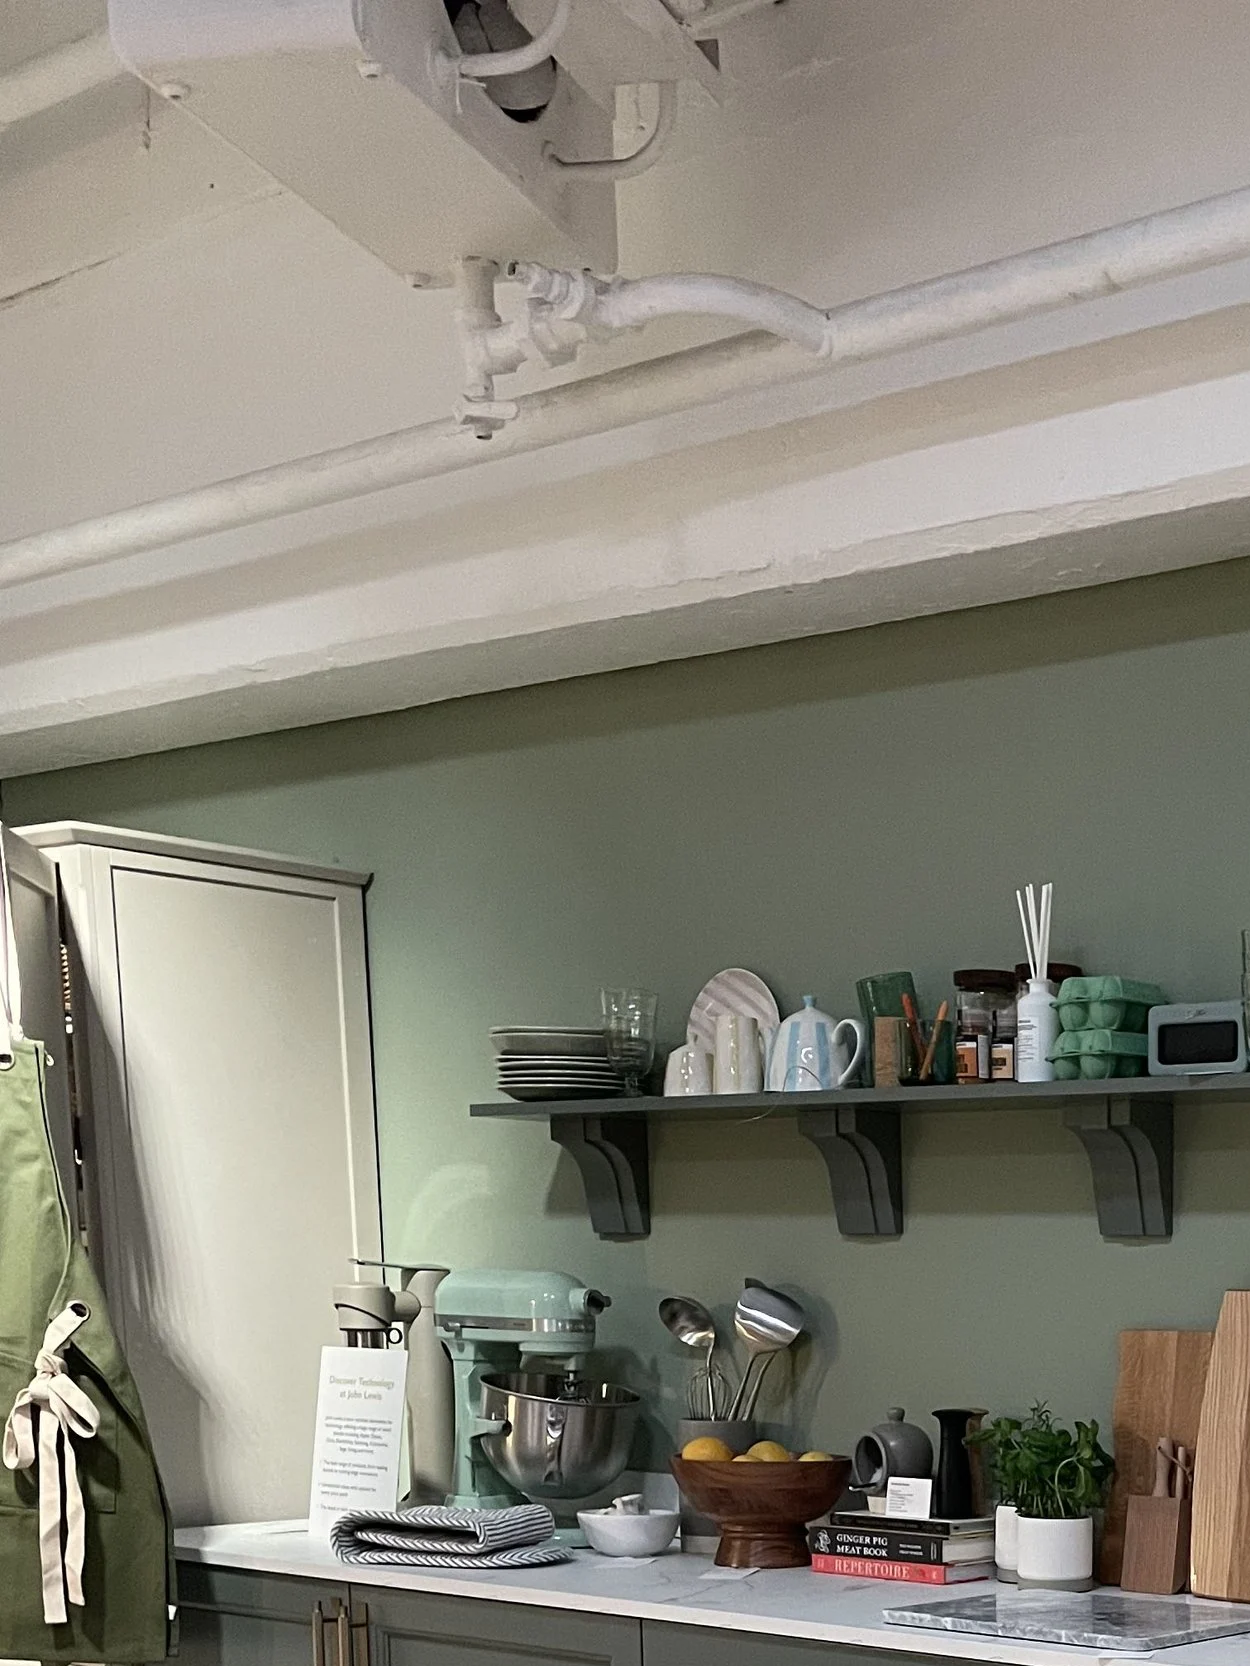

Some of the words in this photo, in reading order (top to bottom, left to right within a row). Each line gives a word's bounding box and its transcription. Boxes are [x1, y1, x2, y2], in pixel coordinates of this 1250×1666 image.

[329, 1375, 357, 1385] Discover
[359, 1376, 394, 1390] Technology
[347, 1390, 362, 1400] John
[364, 1391, 382, 1400] Lewis
[836, 1533, 871, 1544] GINGER
[872, 1537, 888, 1546] PIG
[836, 1545, 861, 1555] MEAT
[863, 1548, 888, 1557] BOOK
[835, 1558, 910, 1578] REPERTOIRE
